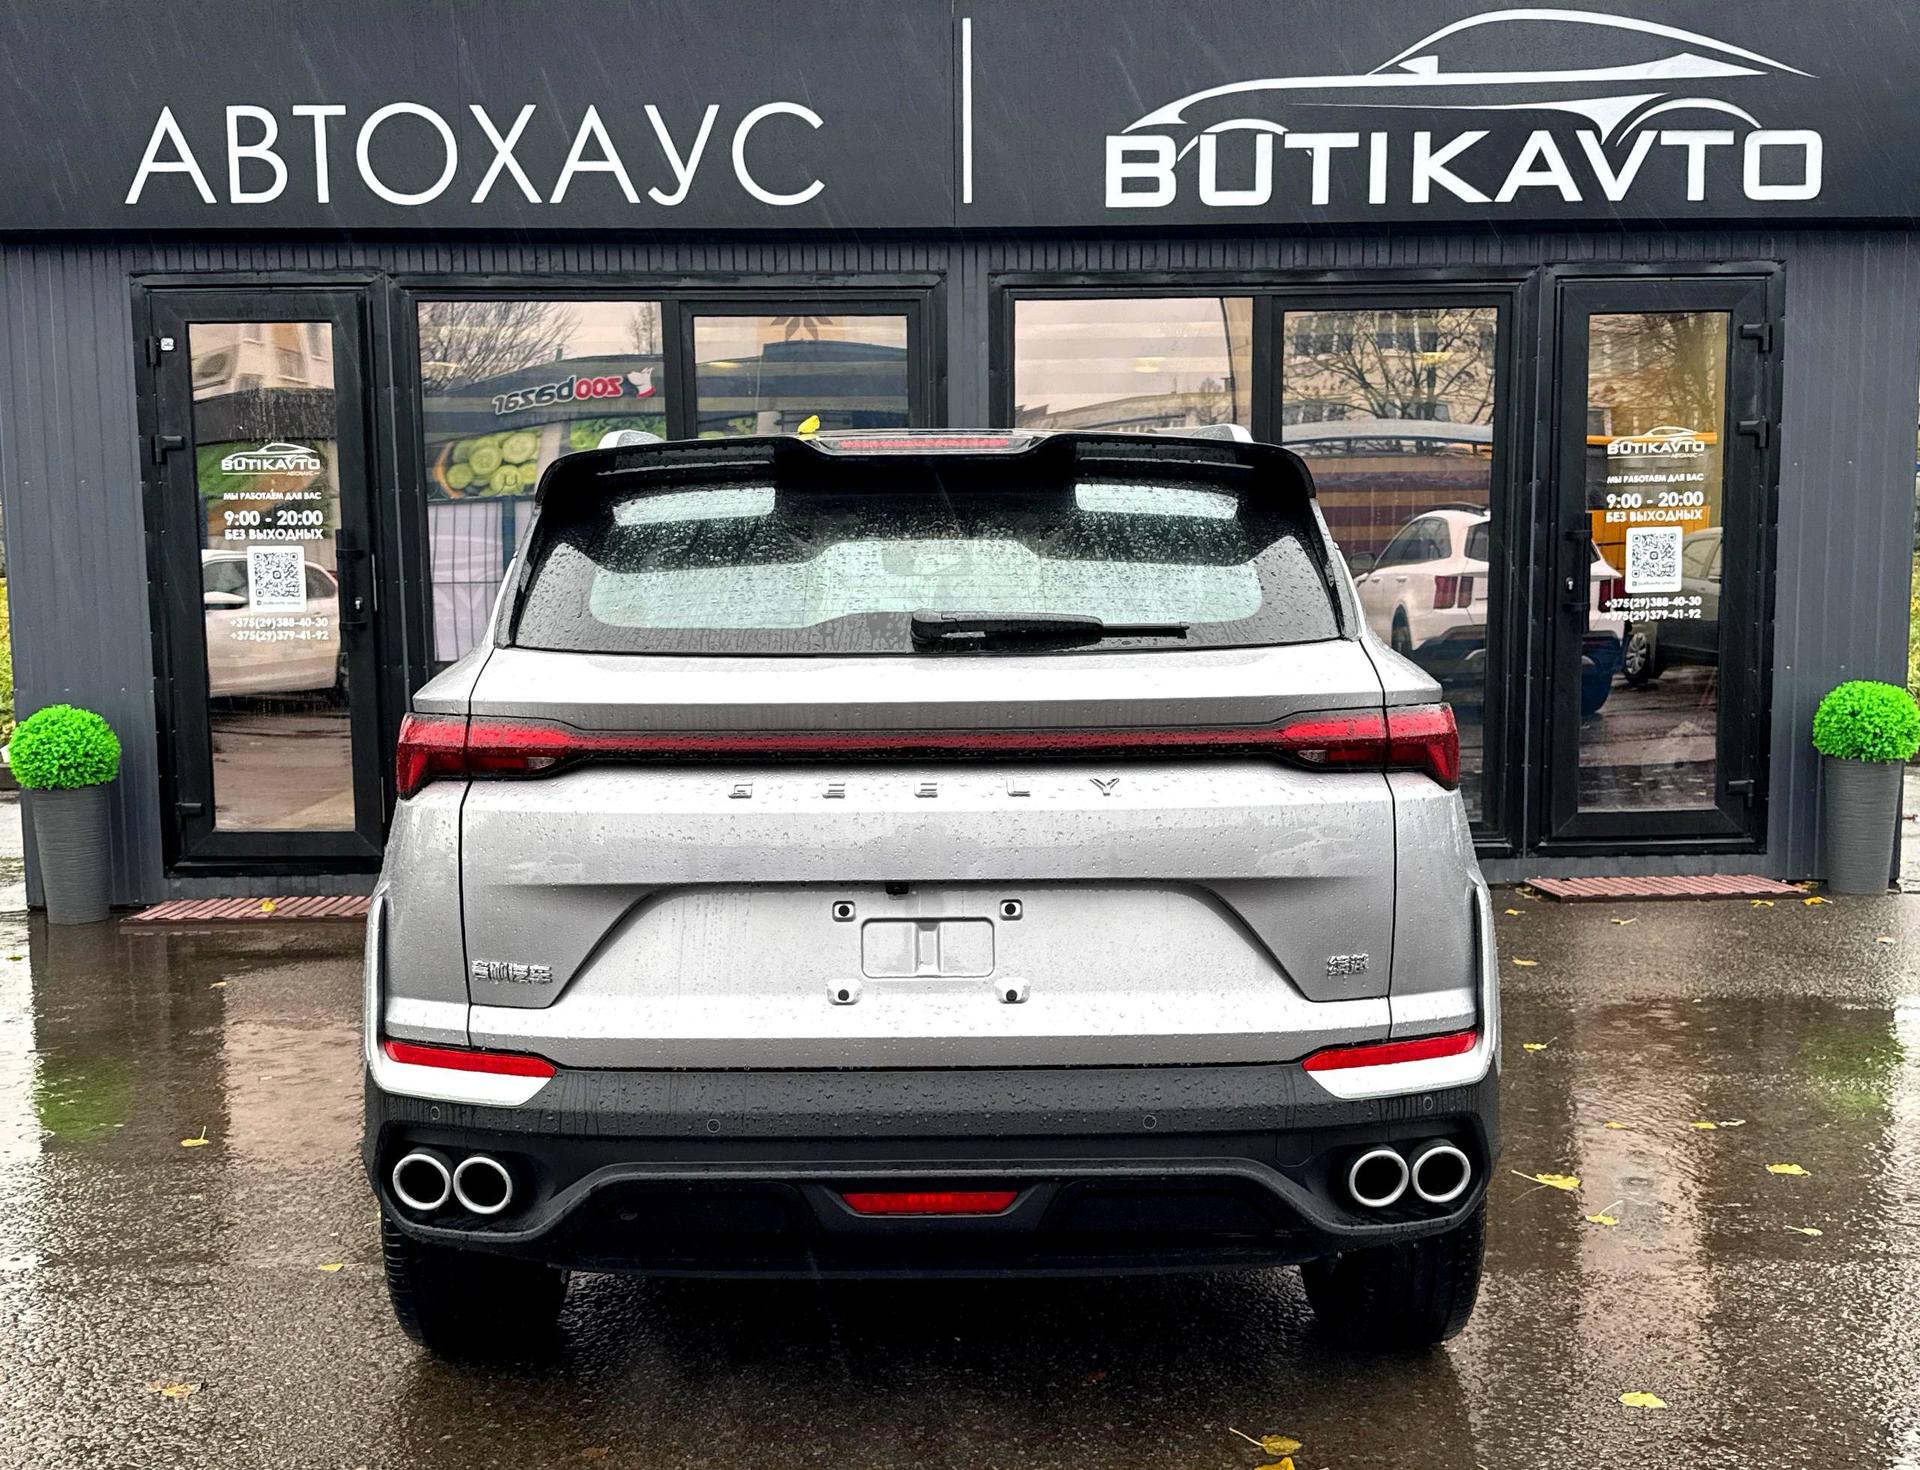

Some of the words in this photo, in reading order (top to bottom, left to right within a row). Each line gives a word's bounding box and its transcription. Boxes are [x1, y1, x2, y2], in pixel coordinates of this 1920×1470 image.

[124, 101, 827, 206] АВТОХАУС
[1105, 129, 1823, 208] BUTIKAVTO
[1607, 440, 1705, 455] BUTIKAVTO
[221, 458, 321, 471] BUTIKAVTO
[1606, 475, 1622, 484] МЫ
[1623, 474, 1666, 483] РАБОТАЕМ
[1667, 474, 1685, 483] ДЛЯ
[1686, 473, 1704, 482] ВАС
[223, 492, 239, 501] МЫ
[239, 492, 284, 501] РАБОТАЕМ
[284, 492, 302, 501] ДЛЯ
[303, 491, 322, 500] ВАС
[1606, 493, 1642, 509] 9:00
[1658, 491, 1704, 508] 20:00
[224, 510, 260, 526] 9:00
[276, 510, 324, 526] 20:00
[1605, 511, 1627, 523] БЕЗ
[1629, 509, 1703, 522] ВЫХОДНЫХ
[224, 529, 246, 541] БЕЗ
[249, 528, 324, 541] ВЫХОДНЫХ
[230, 630, 329, 642] +375(29)379-41-92
[728, 777, 1120, 799] GEELY
